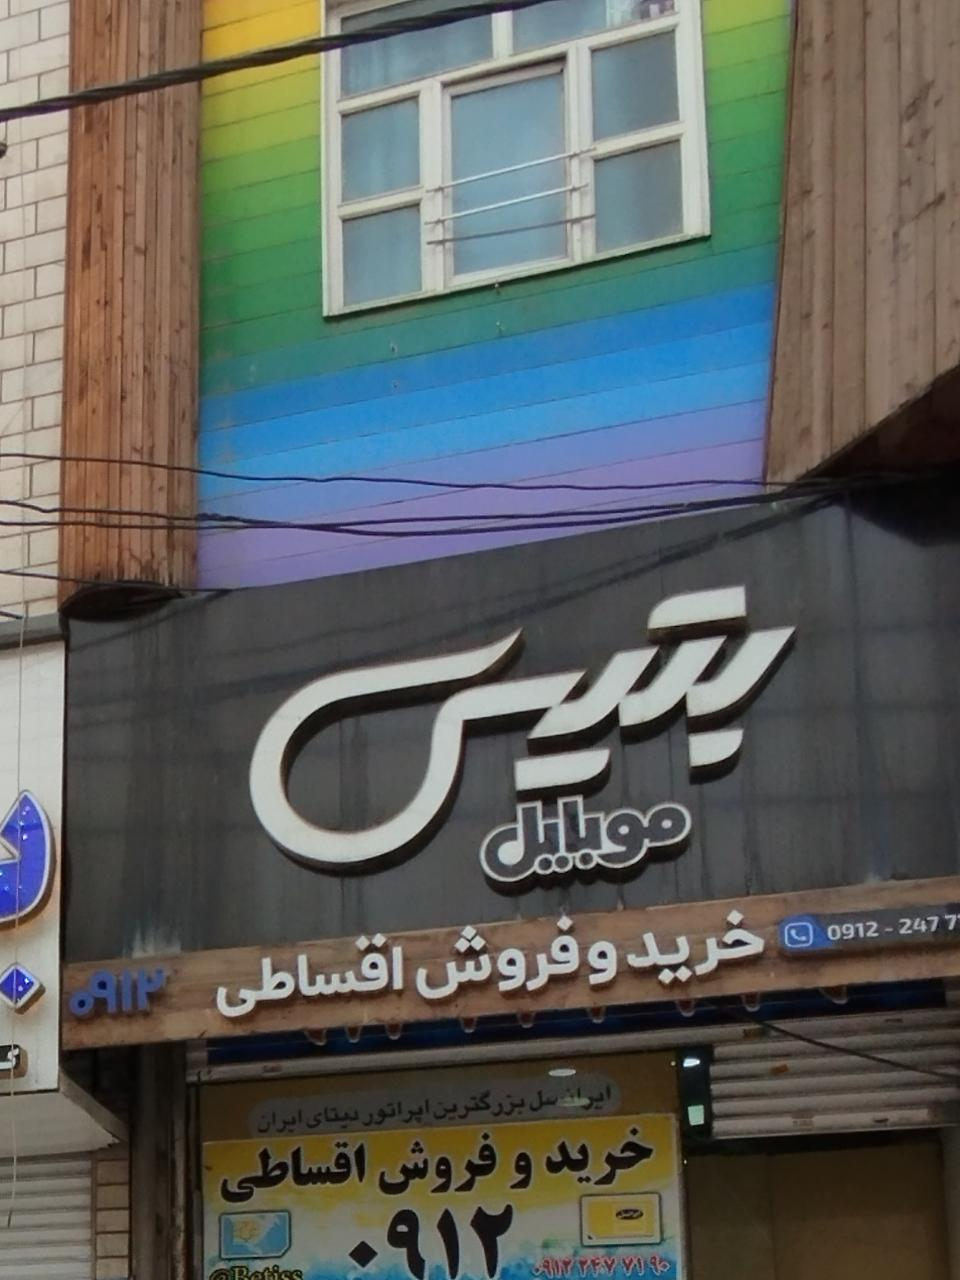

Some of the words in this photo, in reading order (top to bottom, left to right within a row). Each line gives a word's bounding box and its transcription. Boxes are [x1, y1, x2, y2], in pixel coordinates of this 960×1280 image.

[480, 795, 692, 882] موبایل
[417, 915, 580, 998] فروش
[627, 910, 766, 984] خرید
[827, 921, 880, 941] 0912
[898, 915, 939, 935] 247
[944, 913, 960, 931] 7
[70, 967, 165, 1017] ۰۹۱۲
[216, 933, 404, 1017] اقساطی
[589, 941, 617, 984] و
[257, 1110, 303, 1133] ایران
[362, 1099, 430, 1127] اپراتور
[220, 1141, 366, 1203] اقساطی
[378, 1132, 497, 1194] فروش
[510, 1153, 534, 1189] و
[545, 1127, 654, 1186] خرید
[347, 1203, 514, 1280] ۰۹۱۲
